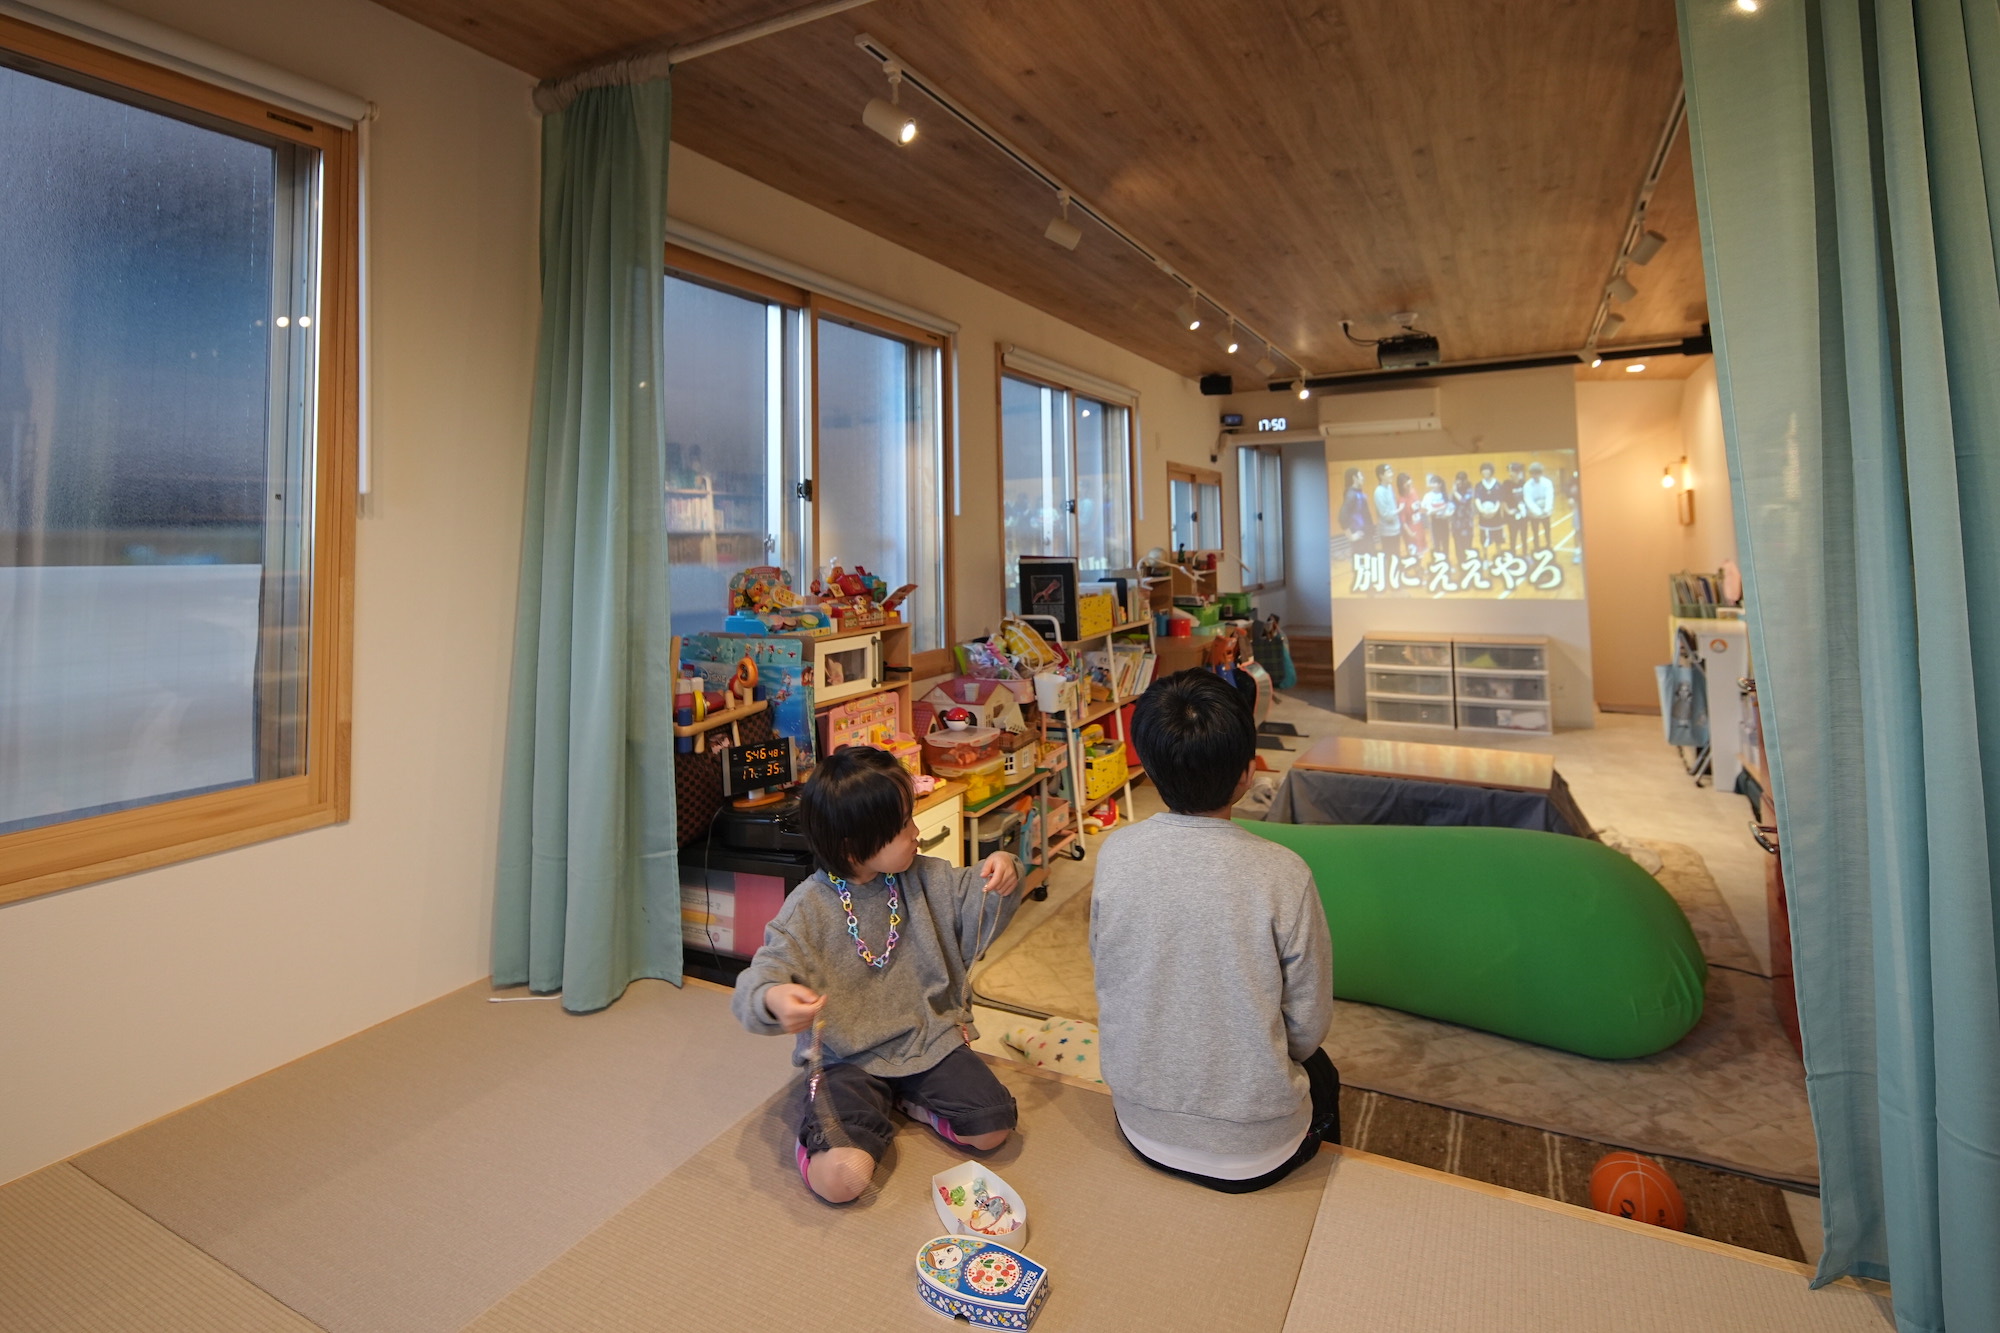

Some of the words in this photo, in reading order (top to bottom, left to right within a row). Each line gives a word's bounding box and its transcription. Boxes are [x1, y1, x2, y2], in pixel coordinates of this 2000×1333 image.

[1258, 417, 1286, 432] 17:50
[1351, 549, 1564, 593] 別にええやろ
